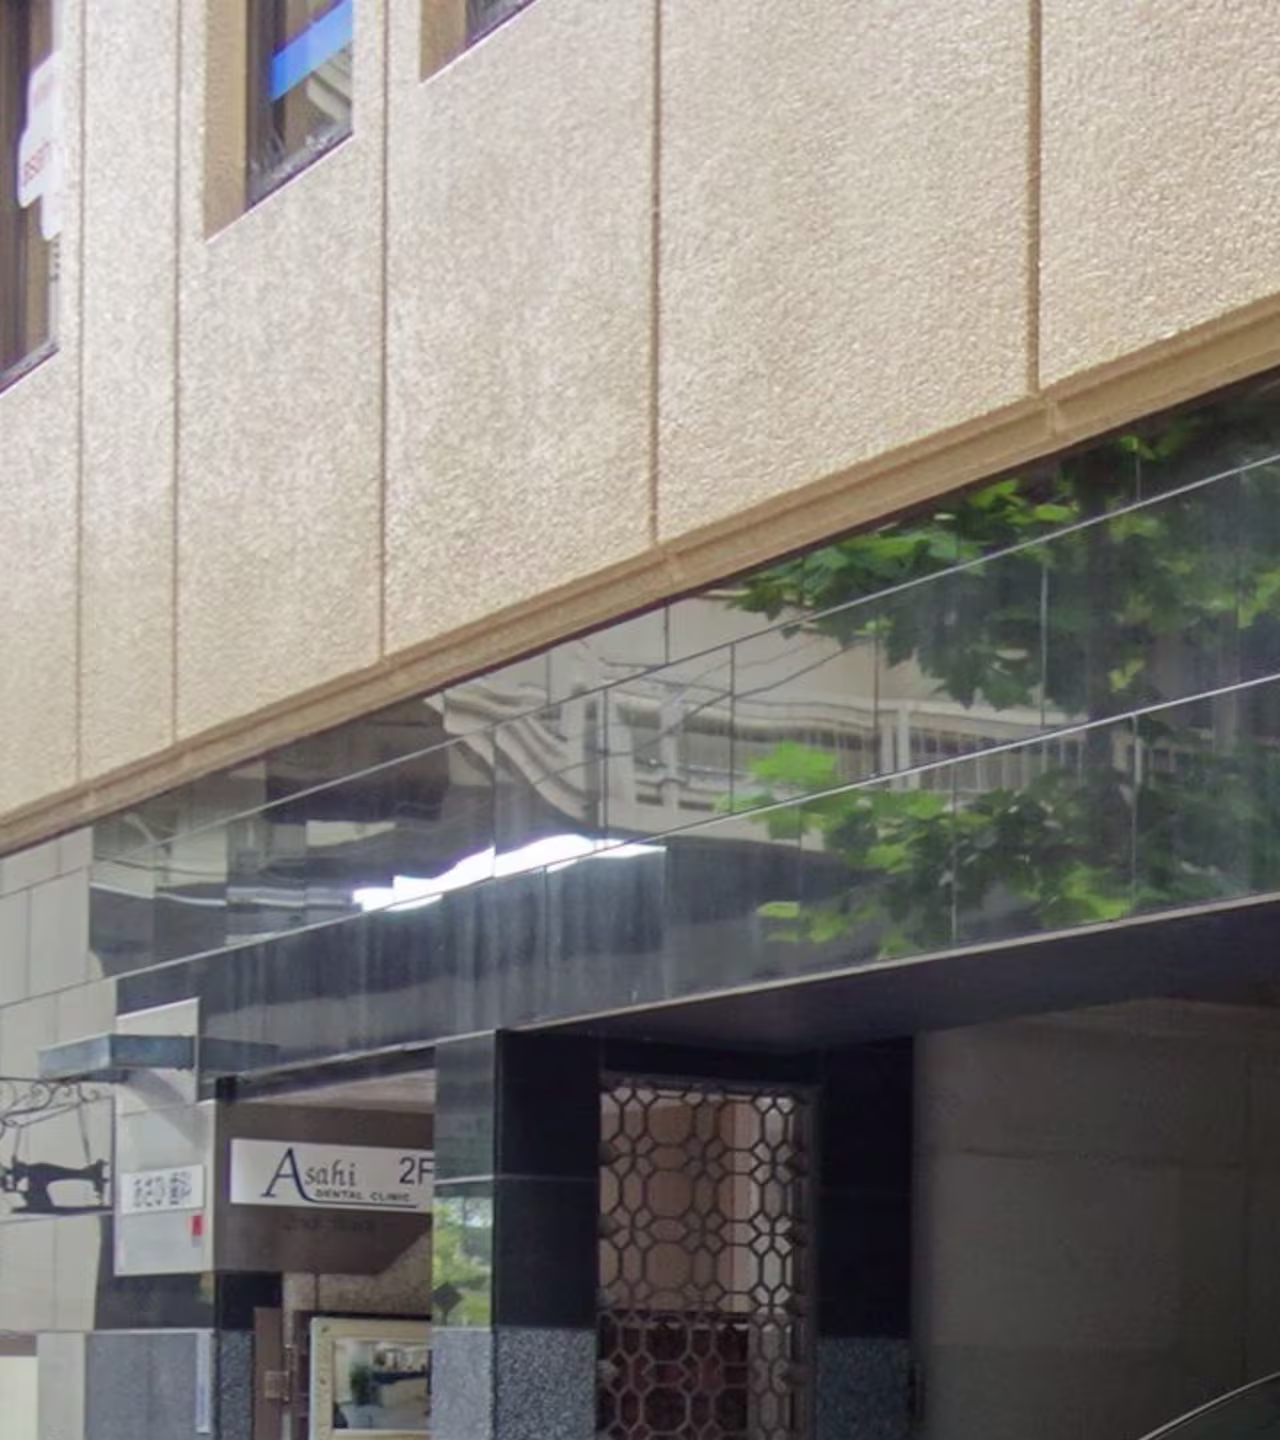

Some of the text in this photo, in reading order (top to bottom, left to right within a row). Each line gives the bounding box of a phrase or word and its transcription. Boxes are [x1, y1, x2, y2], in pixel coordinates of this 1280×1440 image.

[261, 1147, 433, 1200] Asahi 2F
[315, 1189, 411, 1202] DENTAL CLINIC
